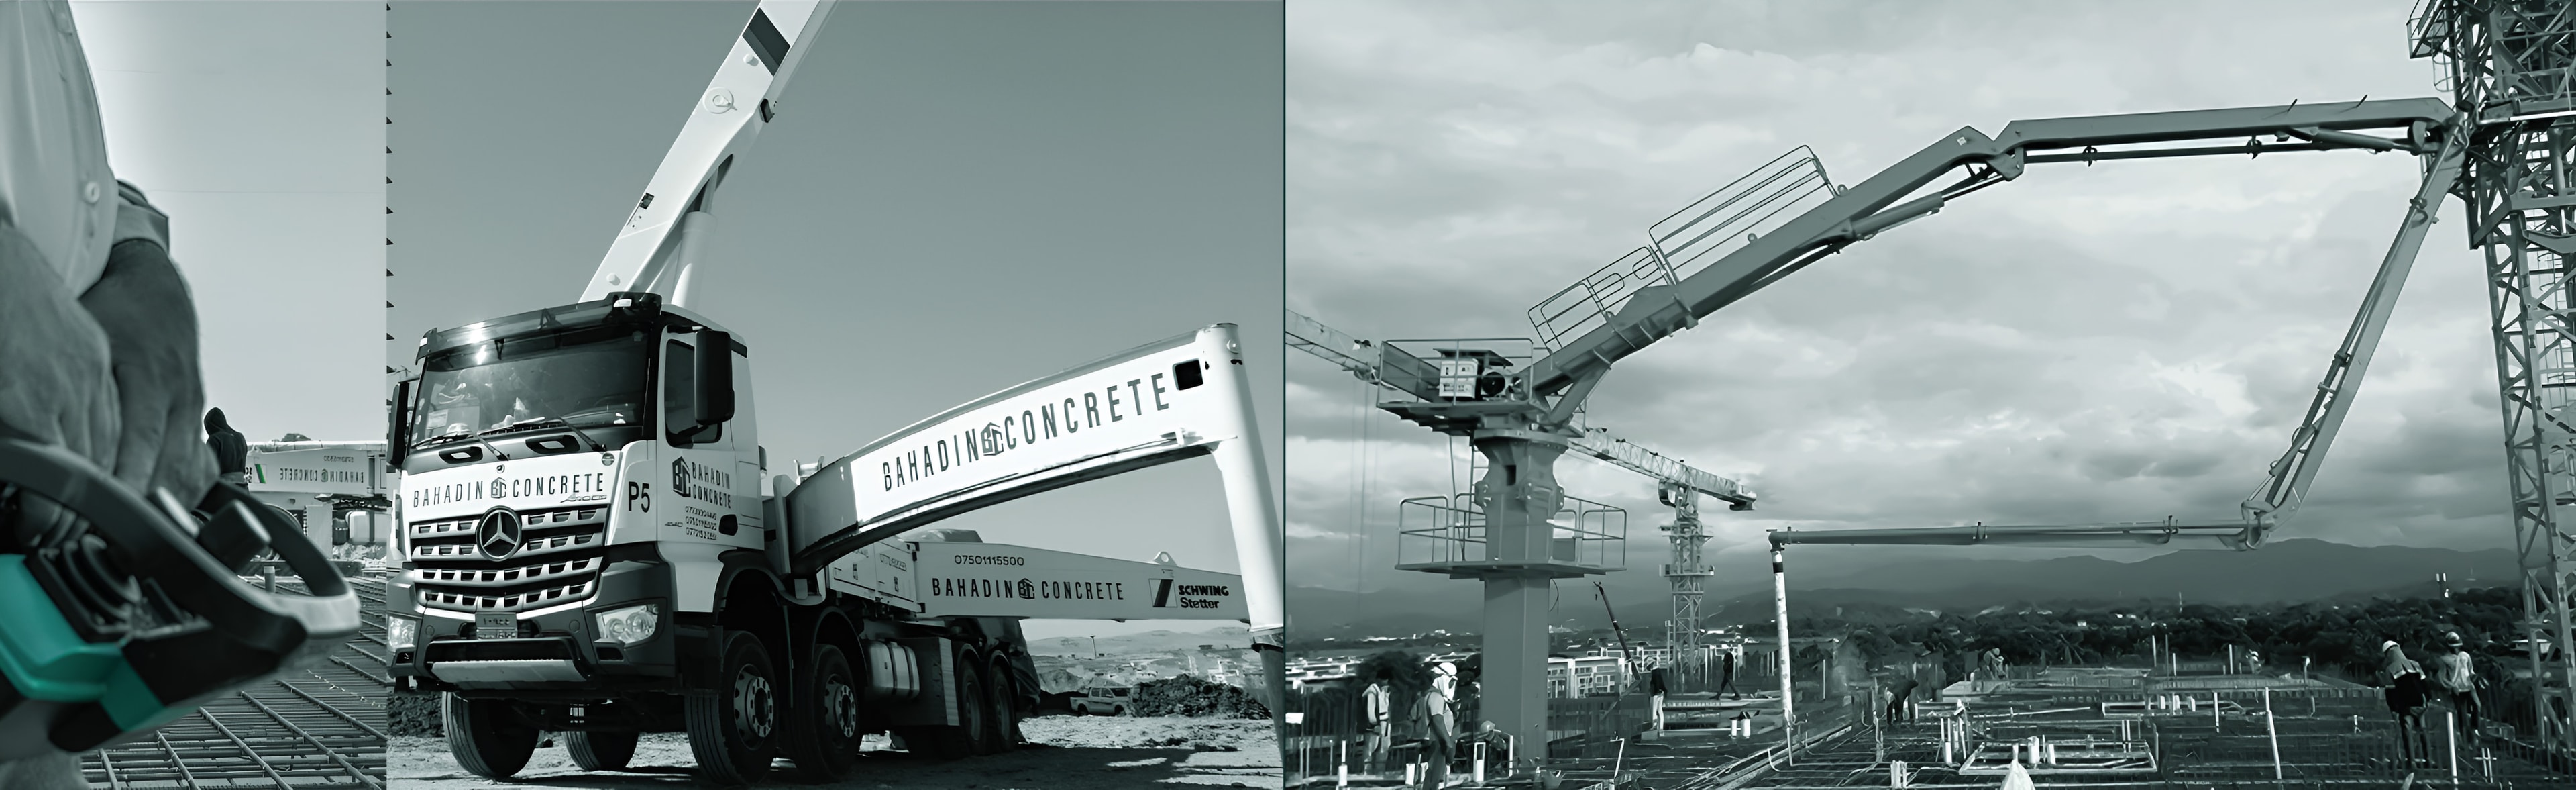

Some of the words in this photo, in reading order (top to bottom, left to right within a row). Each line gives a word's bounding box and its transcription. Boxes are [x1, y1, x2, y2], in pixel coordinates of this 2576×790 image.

[882, 428, 979, 492] BAHADIN
[1004, 373, 1169, 450] CONCRETE
[692, 461, 730, 489] BAHADIN
[413, 480, 483, 507] BAHADIN
[513, 473, 604, 498] CONCRETE
[628, 481, 651, 513] P5
[693, 483, 731, 509] CONCRETE
[954, 554, 1025, 566] 07501115500
[932, 577, 1014, 599] BAHADIN
[1041, 580, 1124, 601] CONCRETE
[1178, 585, 1230, 597] SCHWING
[1180, 597, 1220, 609] Stetter
